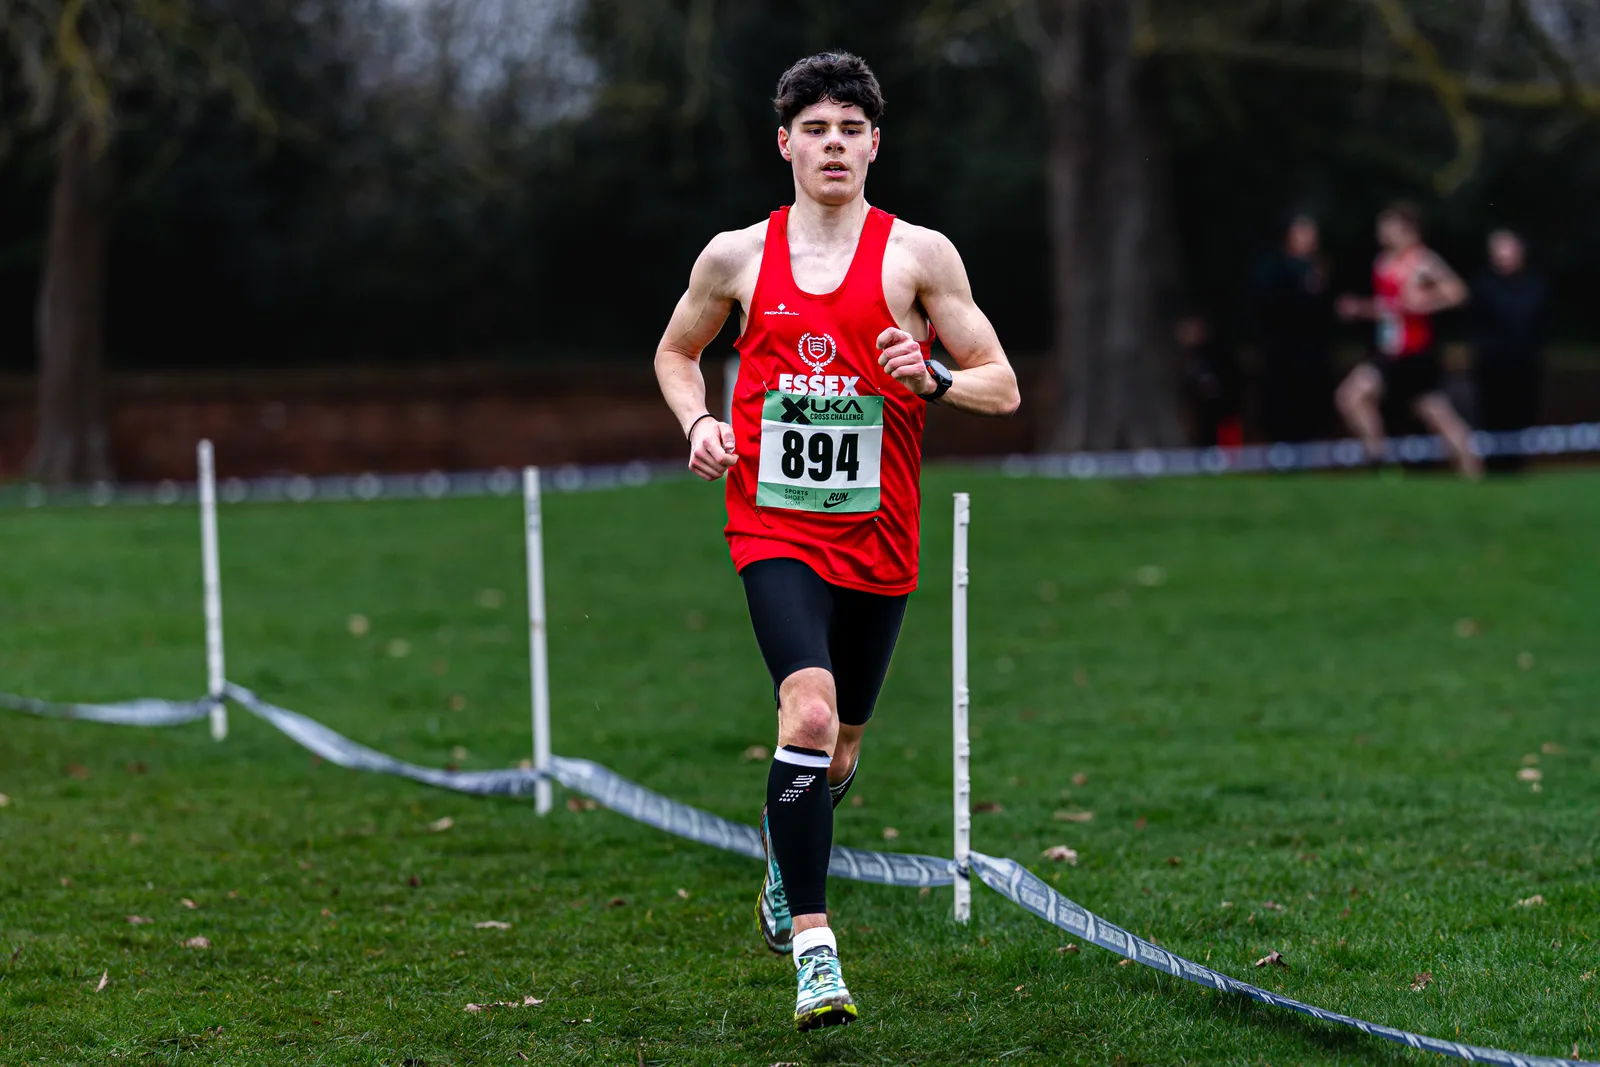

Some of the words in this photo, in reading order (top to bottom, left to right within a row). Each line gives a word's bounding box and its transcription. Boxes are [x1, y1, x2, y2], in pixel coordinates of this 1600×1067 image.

[778, 373, 860, 397] ESSEX
[810, 413, 830, 421] CROSS
[831, 413, 864, 421] CHALLENGE
[781, 430, 859, 482] 894
[784, 488, 809, 496] SPORTS
[784, 494, 805, 502] SHOES
[829, 492, 849, 501] RUN
